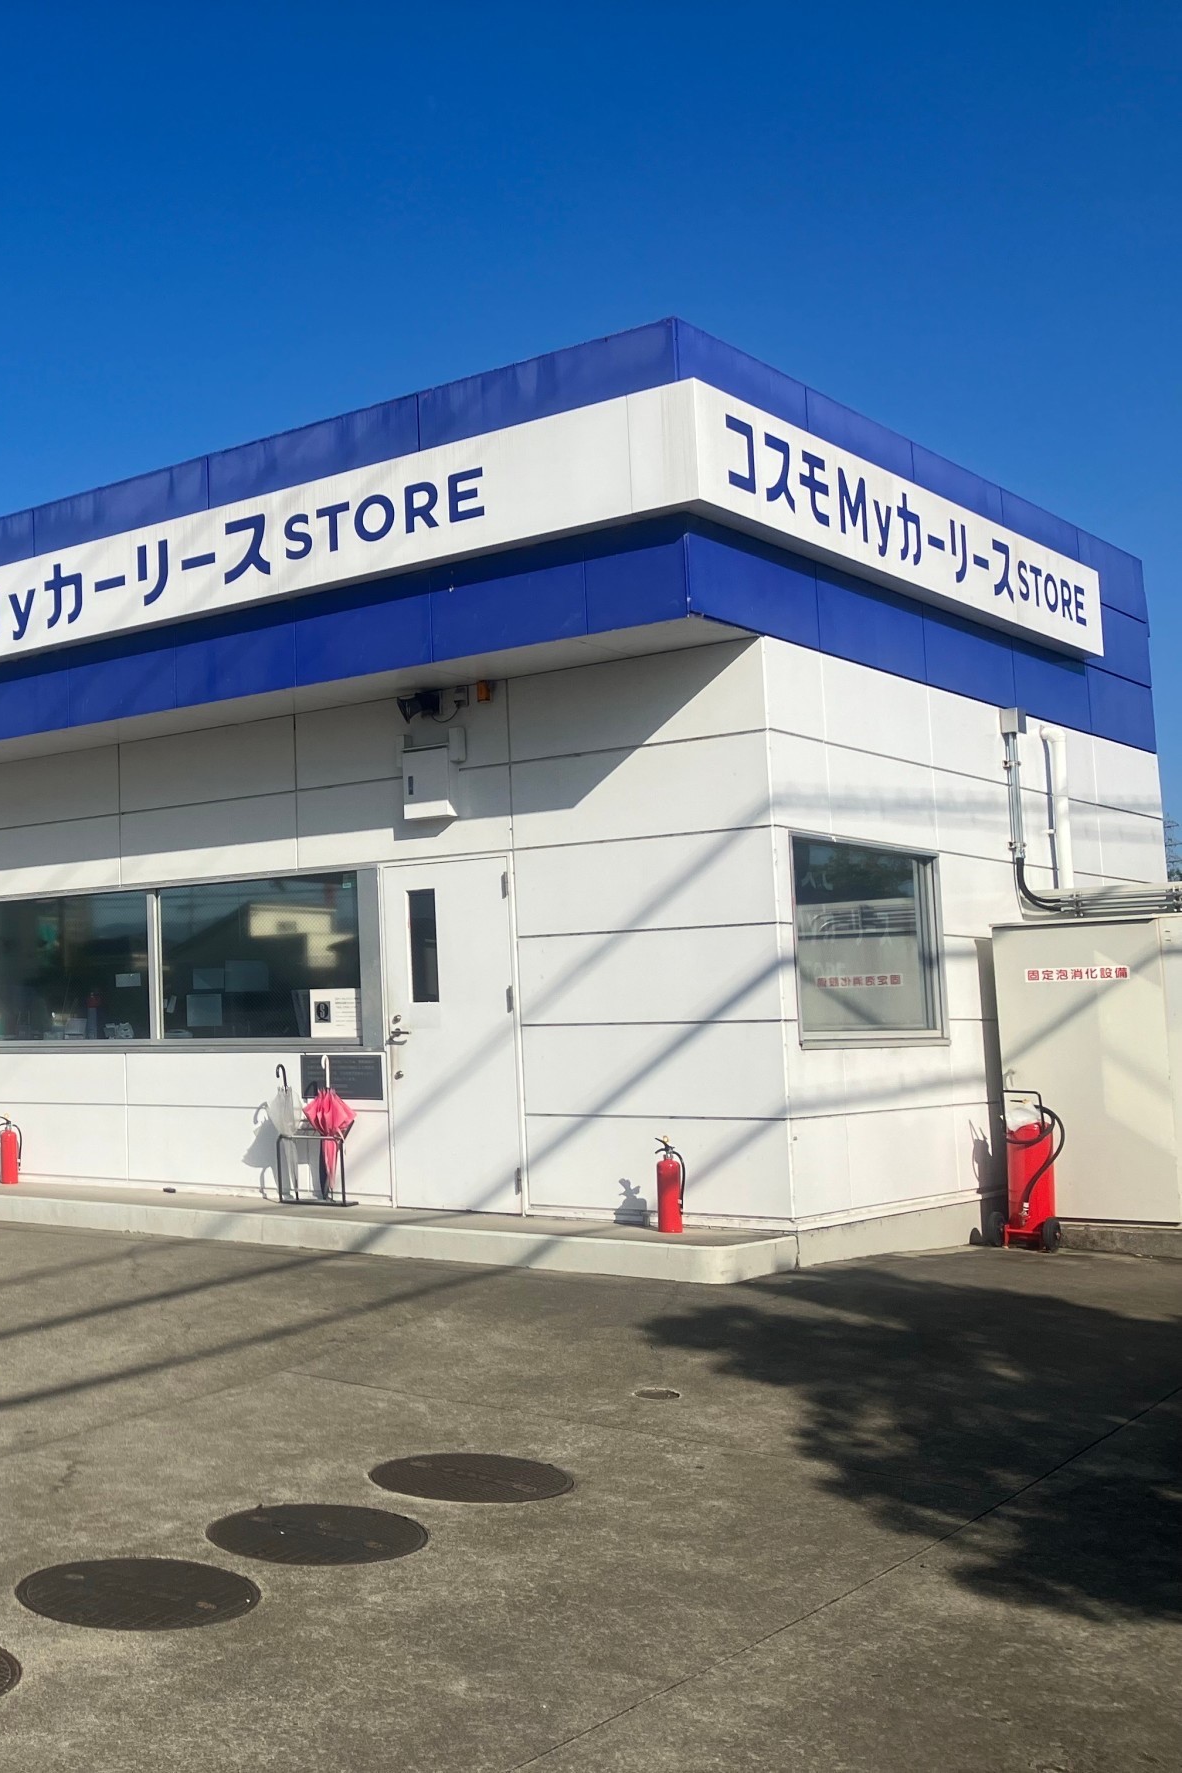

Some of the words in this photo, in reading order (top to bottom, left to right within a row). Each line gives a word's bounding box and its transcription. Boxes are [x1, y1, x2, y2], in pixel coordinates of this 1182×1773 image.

[1027, 967, 1129, 981] 固定泡消化設備
